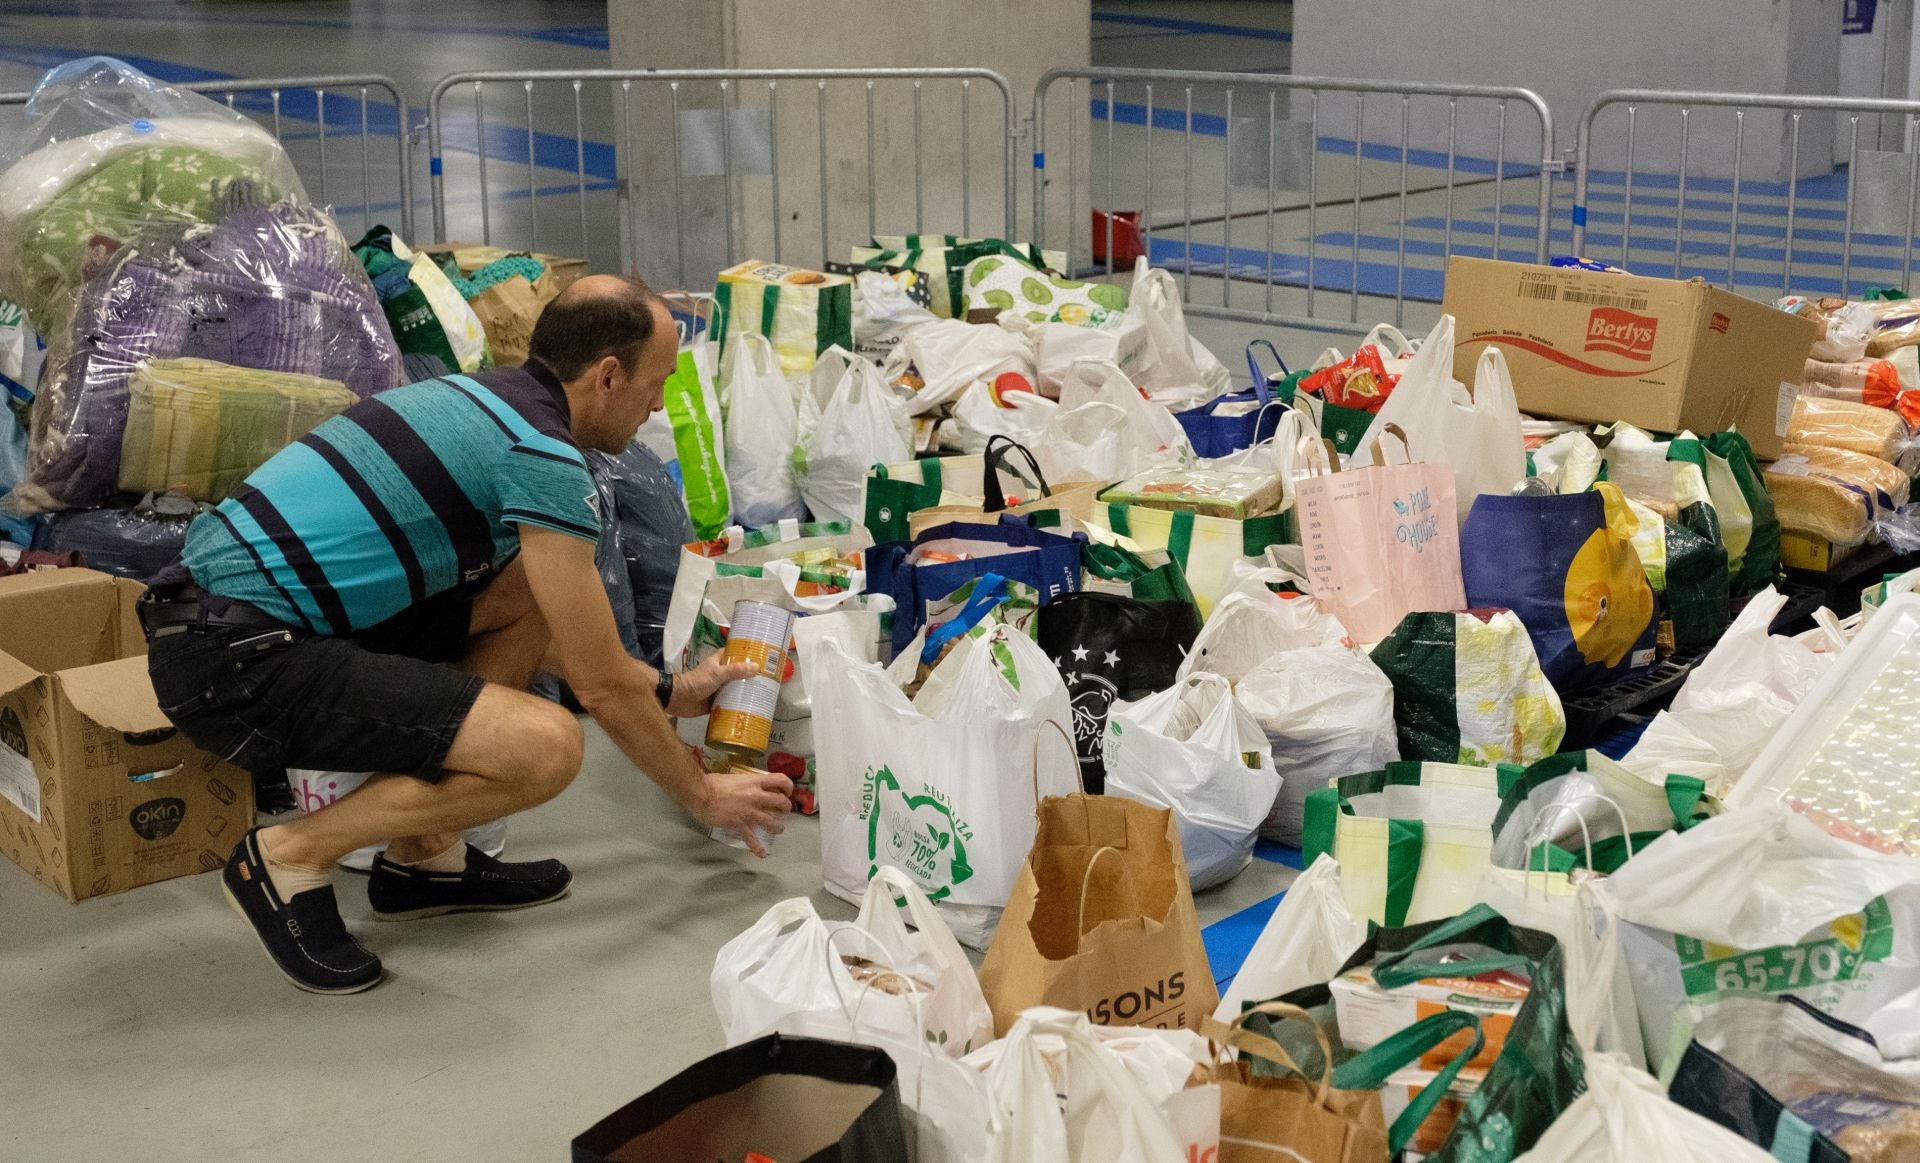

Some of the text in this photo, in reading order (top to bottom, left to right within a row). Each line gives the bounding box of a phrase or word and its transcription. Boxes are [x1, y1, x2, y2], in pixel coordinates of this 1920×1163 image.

[1520, 271, 1551, 281] 210731
[1590, 318, 1652, 347] Berlys
[1410, 487, 1432, 516] POKE
[1403, 515, 1437, 553] HOUSE
[914, 831, 930, 844] BOLSA
[910, 840, 936, 870] 70%
[905, 860, 932, 880] RECICLADA
